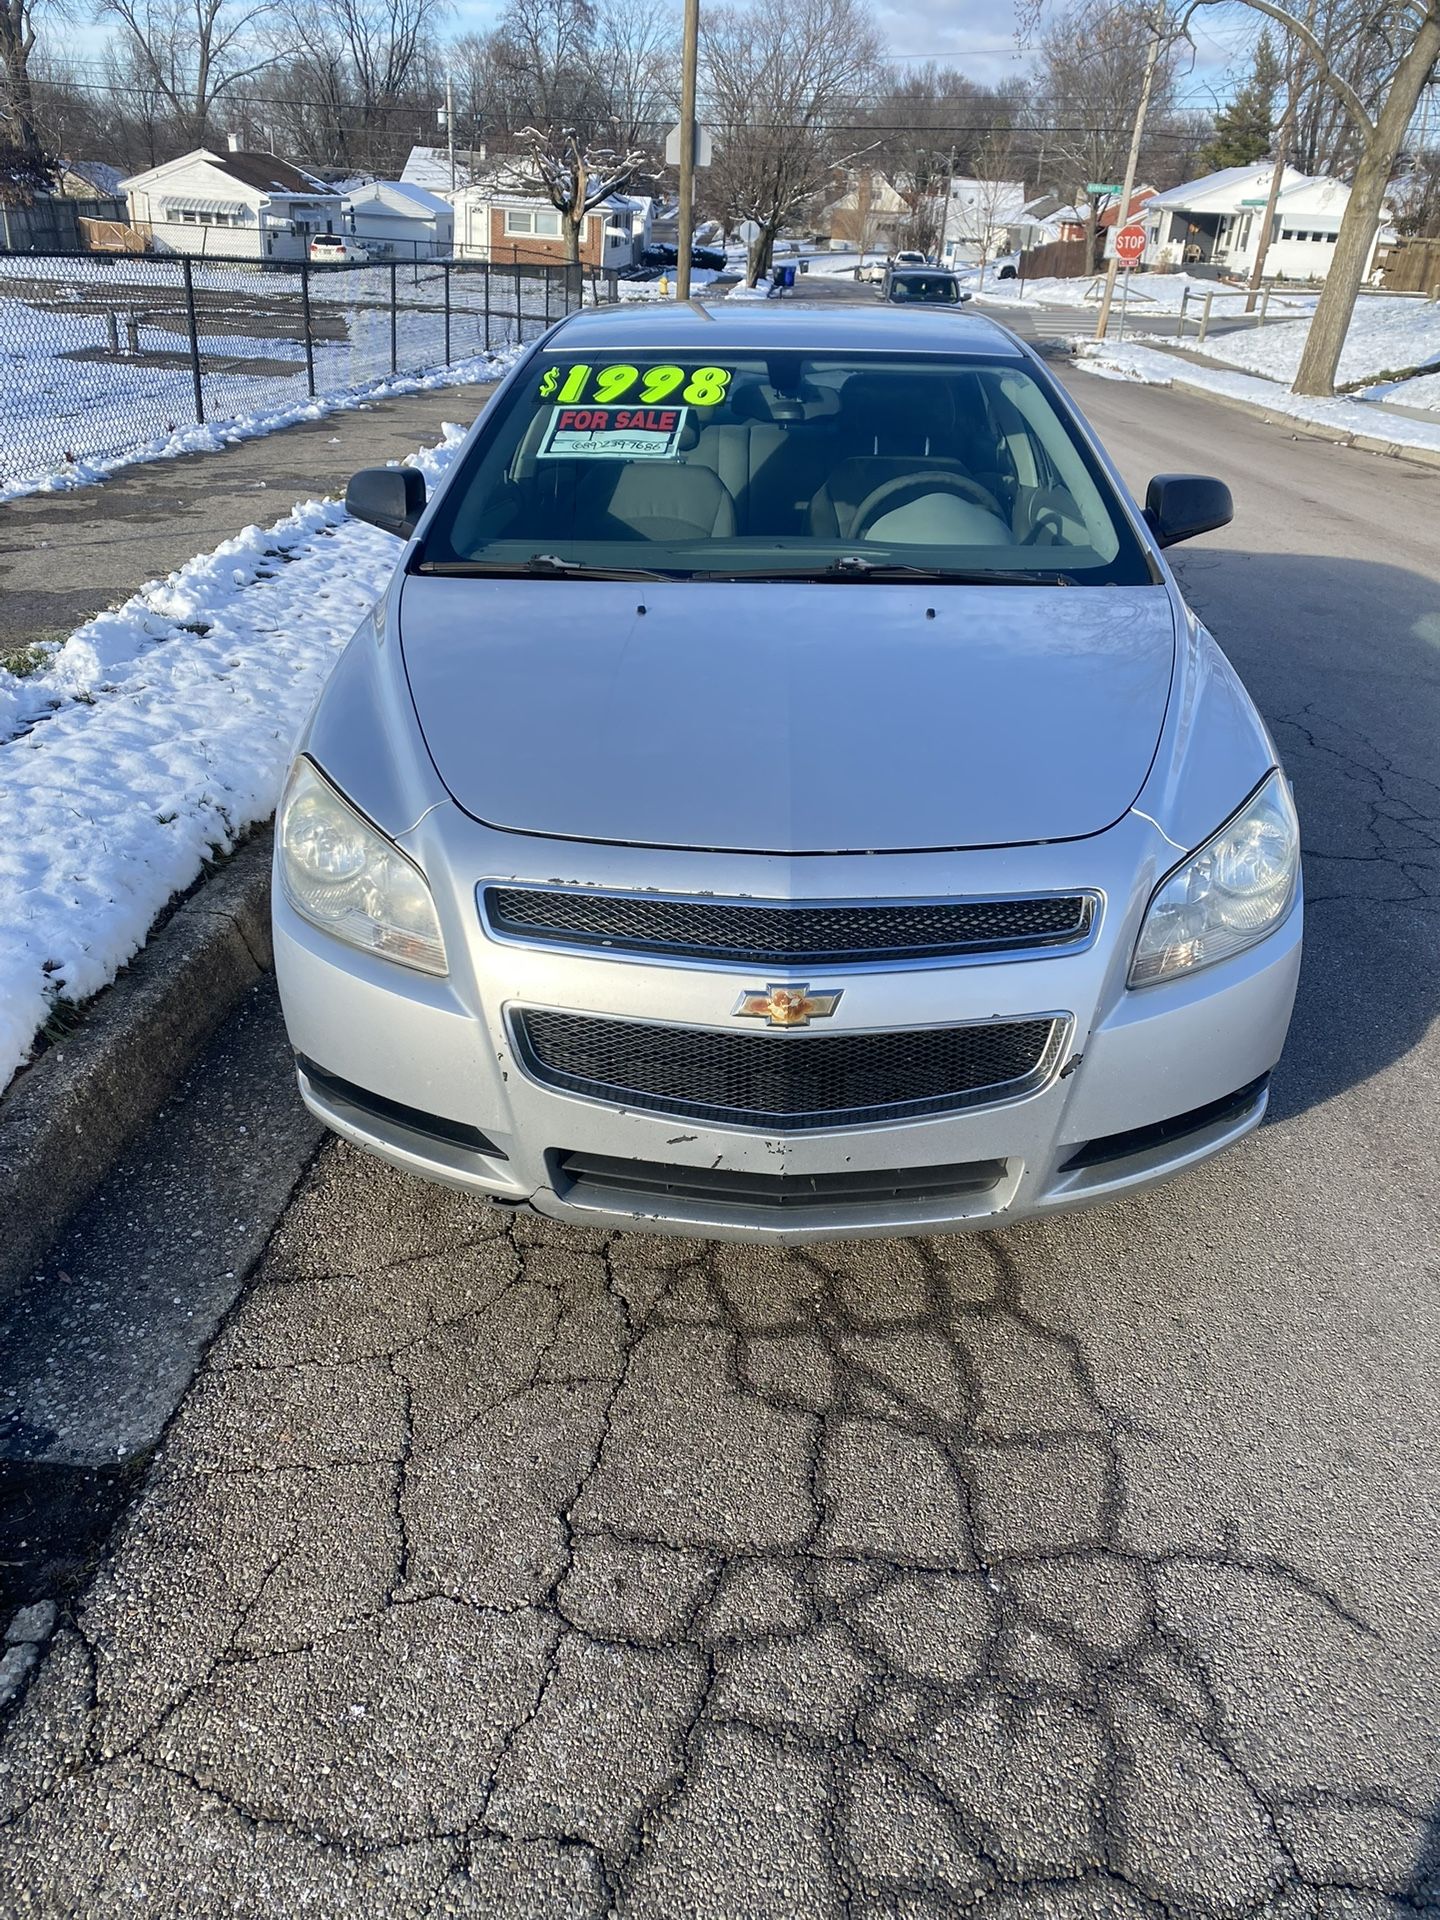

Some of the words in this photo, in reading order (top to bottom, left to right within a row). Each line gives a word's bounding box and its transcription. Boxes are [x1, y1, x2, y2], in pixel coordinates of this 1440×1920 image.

[1117, 235, 1145, 249] STOP
[539, 364, 731, 406] $1998
[559, 411, 609, 430] FOR
[614, 411, 676, 430] SALE
